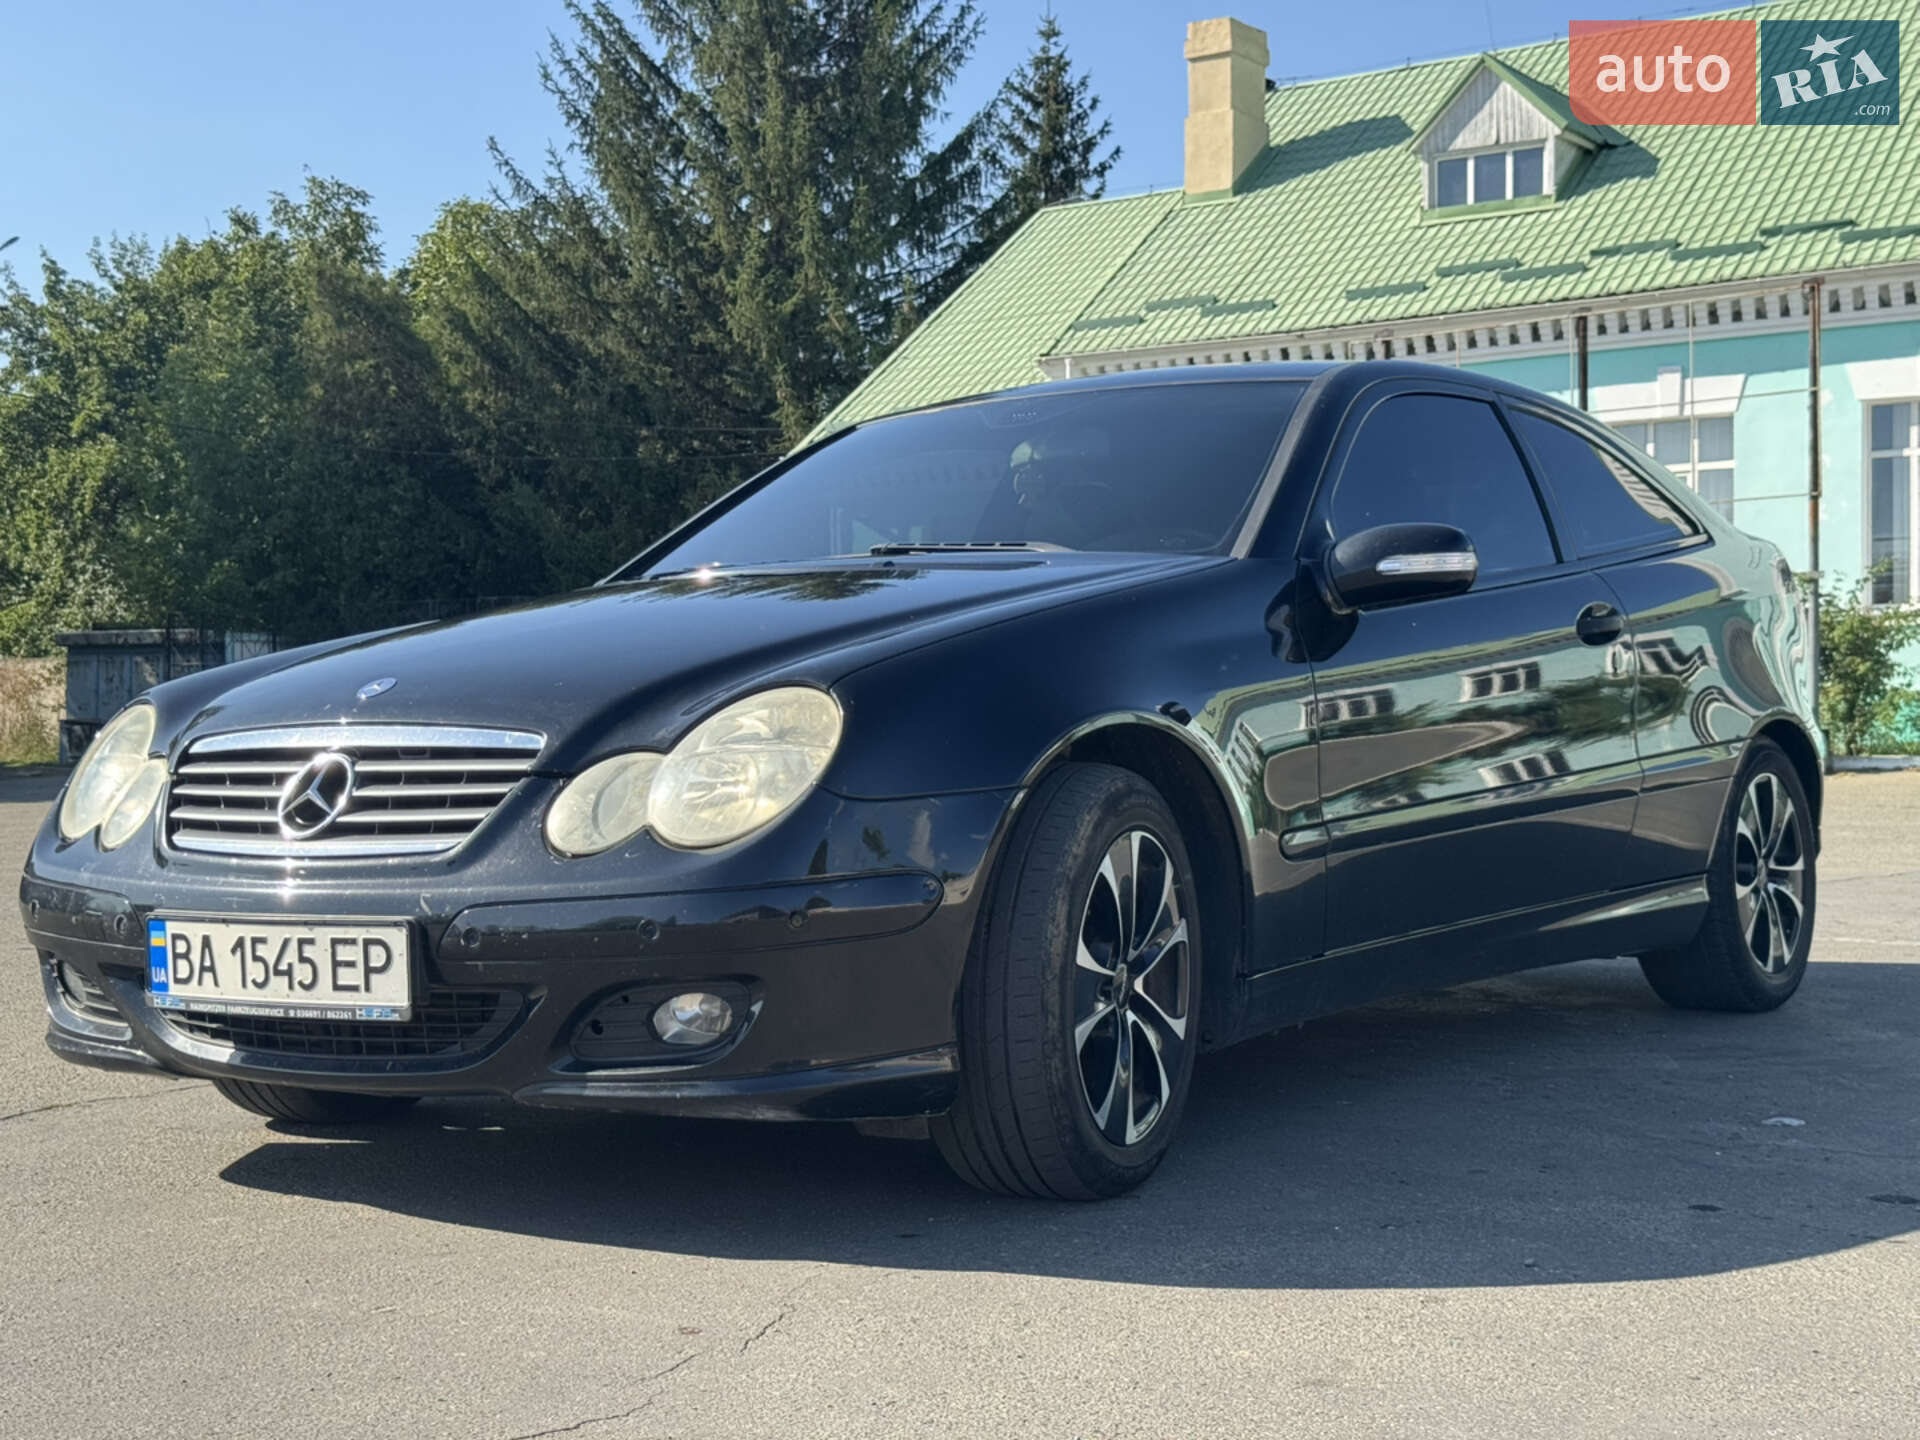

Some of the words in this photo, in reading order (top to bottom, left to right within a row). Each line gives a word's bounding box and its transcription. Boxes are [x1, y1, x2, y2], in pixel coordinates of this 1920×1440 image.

[152, 967, 168, 983] UA
[171, 932, 220, 987] BA
[230, 936, 318, 991] 1545
[330, 937, 393, 993] EP
